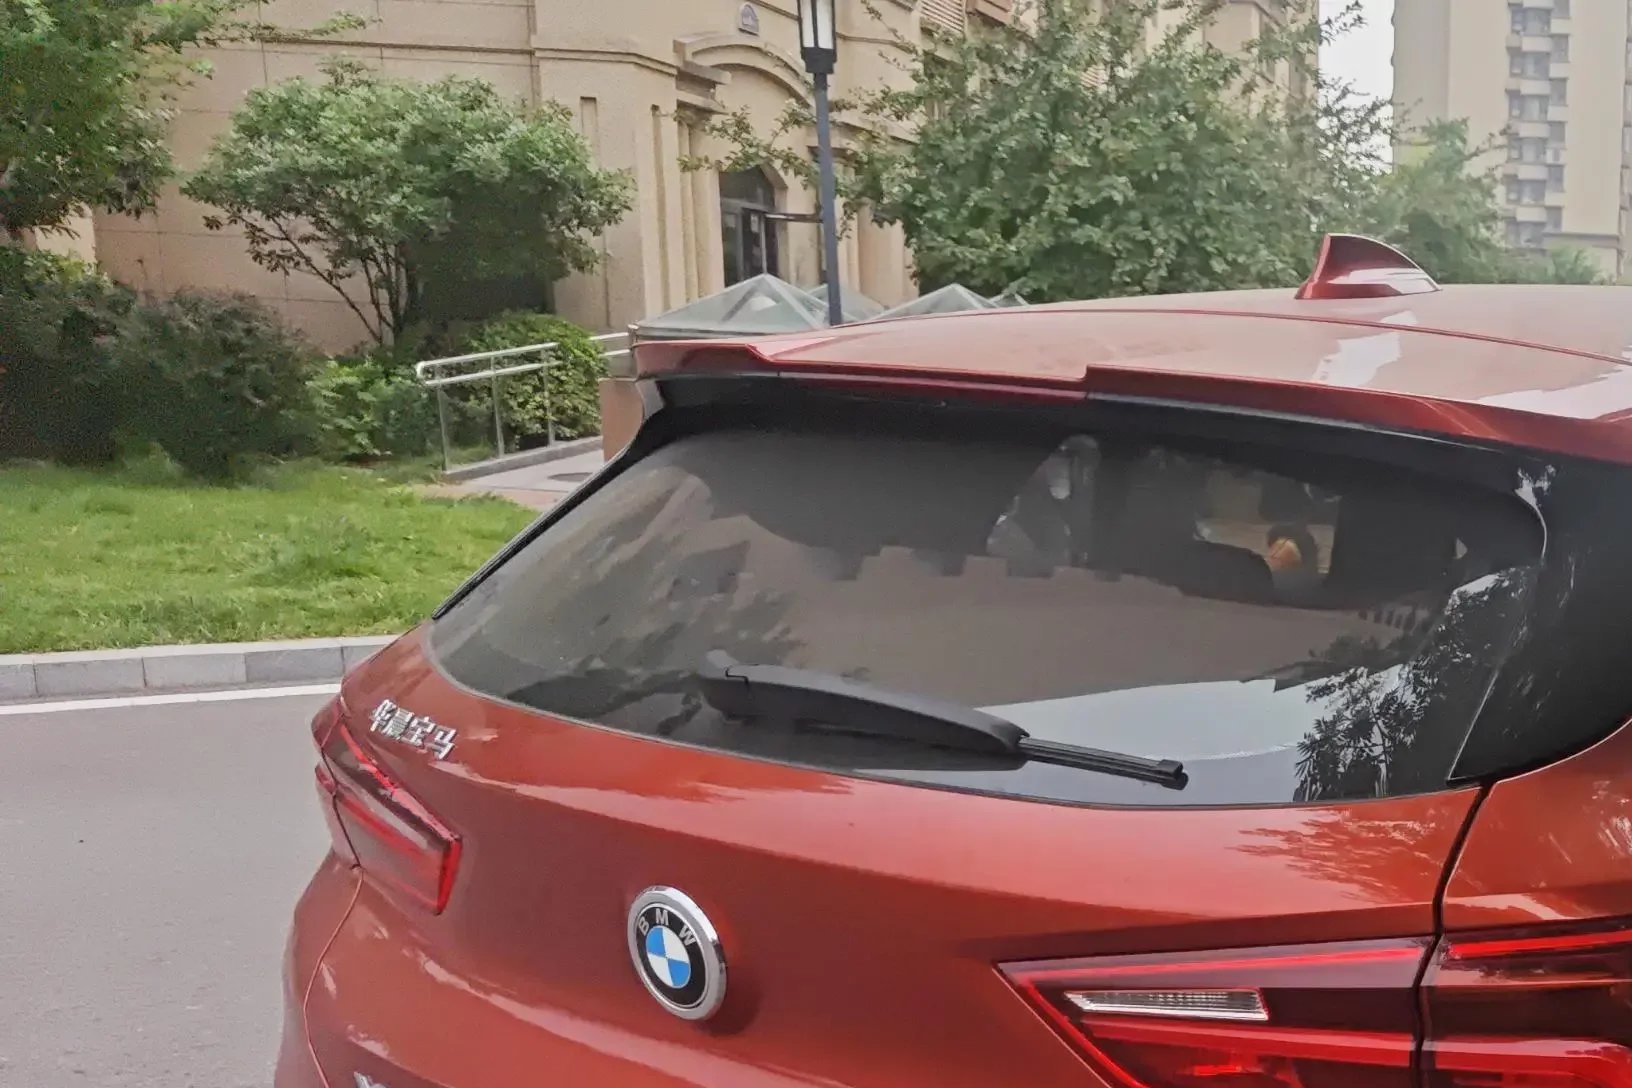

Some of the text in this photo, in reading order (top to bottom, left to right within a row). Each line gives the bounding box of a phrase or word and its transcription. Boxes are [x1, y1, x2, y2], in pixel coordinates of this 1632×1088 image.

[369, 699, 457, 759] 华晨宝马
[638, 908, 698, 946] BMW
